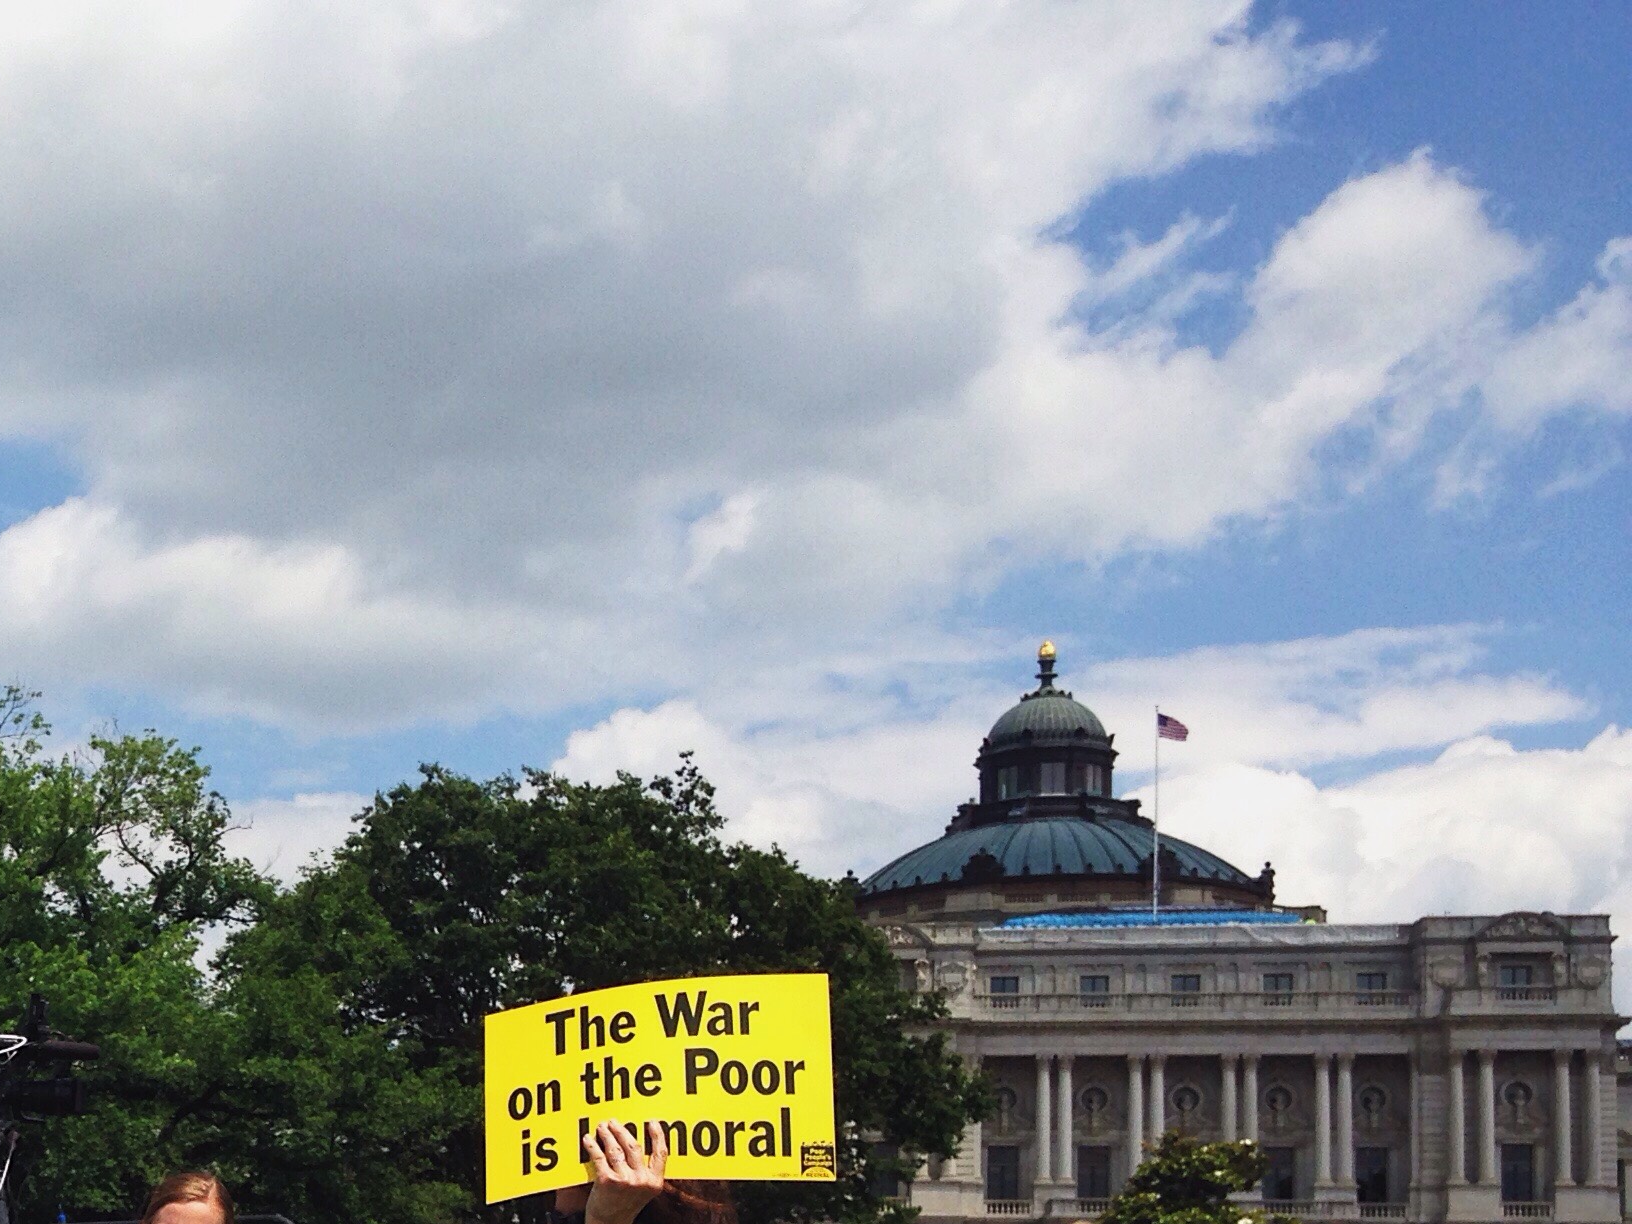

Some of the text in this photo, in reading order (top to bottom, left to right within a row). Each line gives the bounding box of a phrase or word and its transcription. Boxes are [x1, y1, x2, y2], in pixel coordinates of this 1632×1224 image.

[545, 990, 759, 1056] The War
[508, 1047, 805, 1121] on the Poor
[522, 1106, 792, 1176] is Imoral
